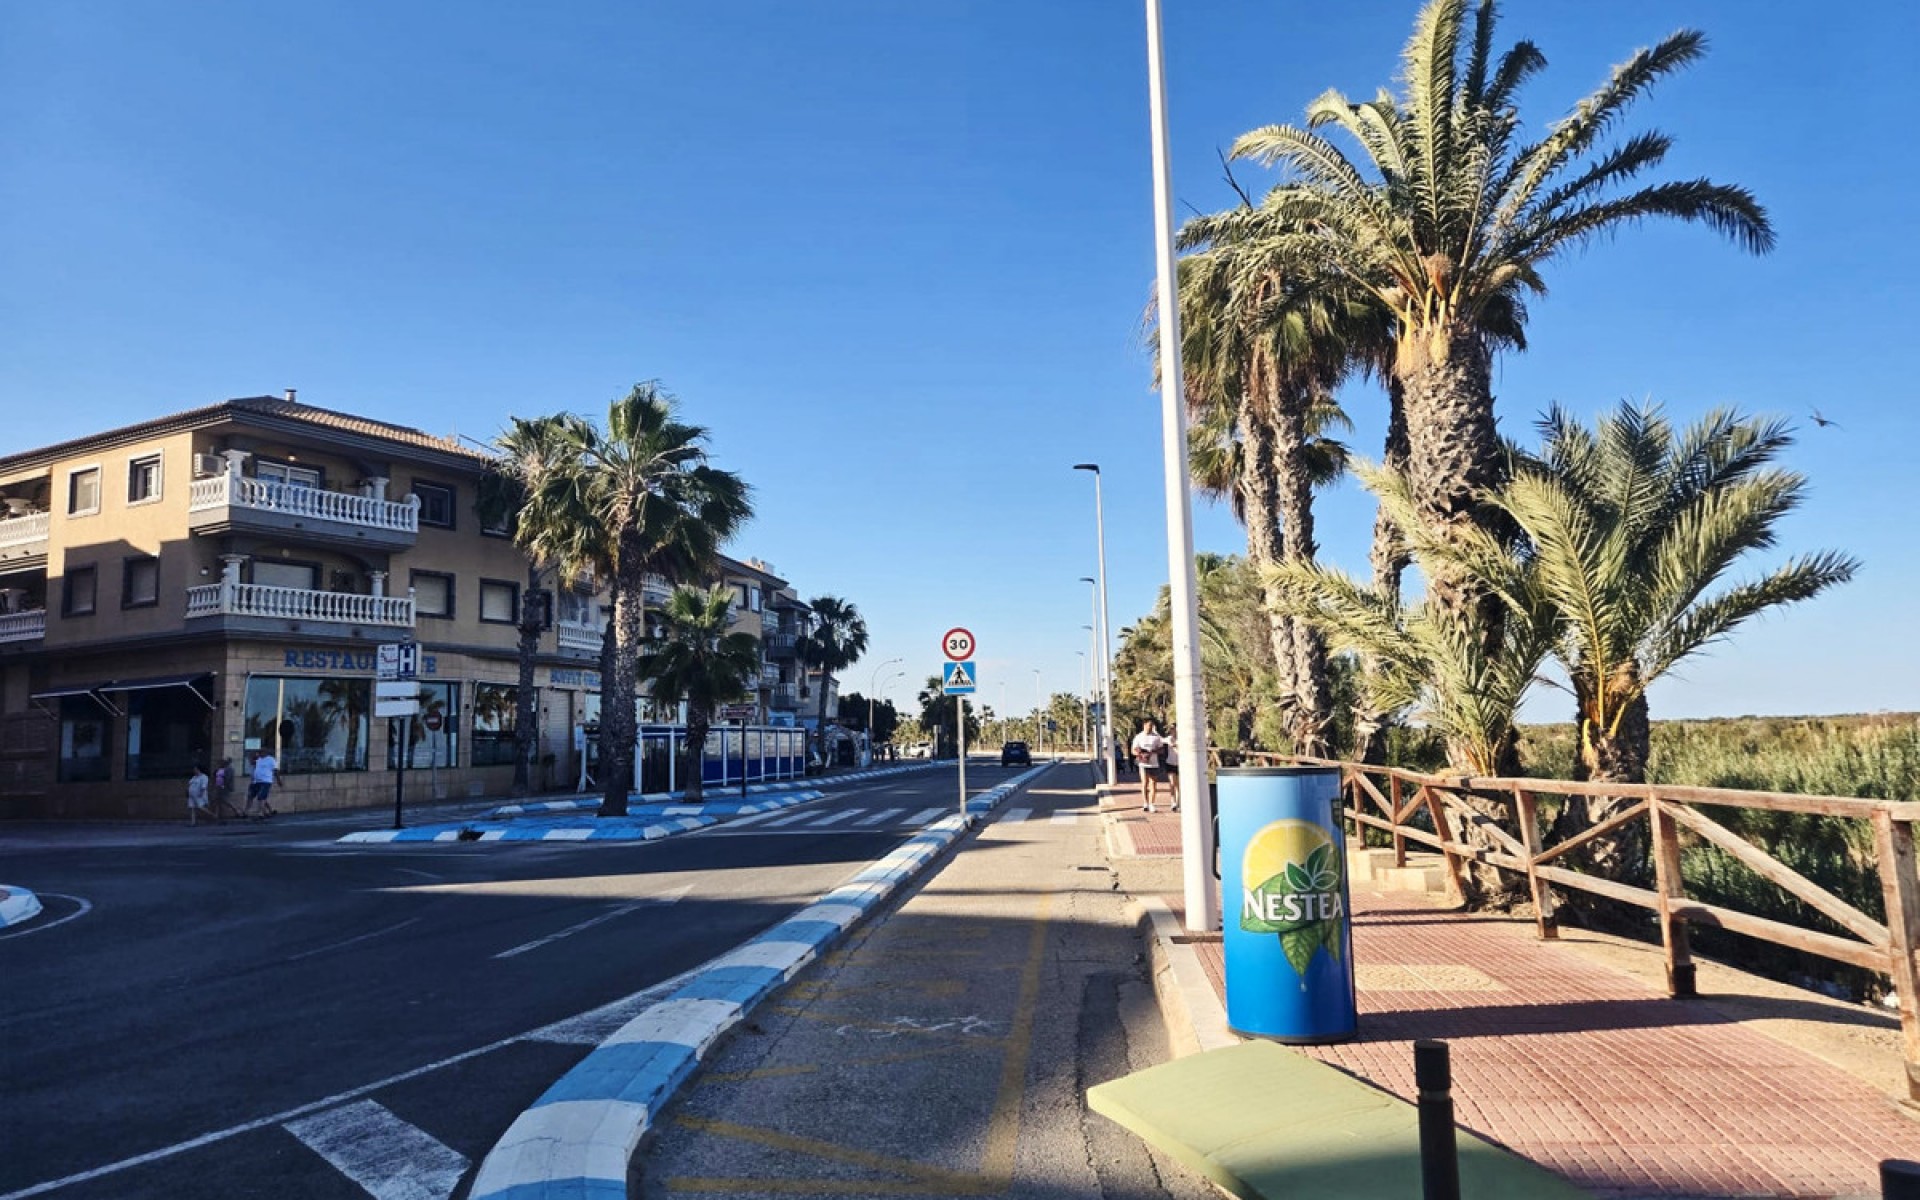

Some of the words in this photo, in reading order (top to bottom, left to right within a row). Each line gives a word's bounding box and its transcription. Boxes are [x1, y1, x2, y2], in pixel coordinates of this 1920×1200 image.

[949, 639, 969, 650] 30
[284, 649, 437, 674] RESTAUE
[399, 648, 414, 671] H
[1243, 887, 1344, 921] NESTEA
